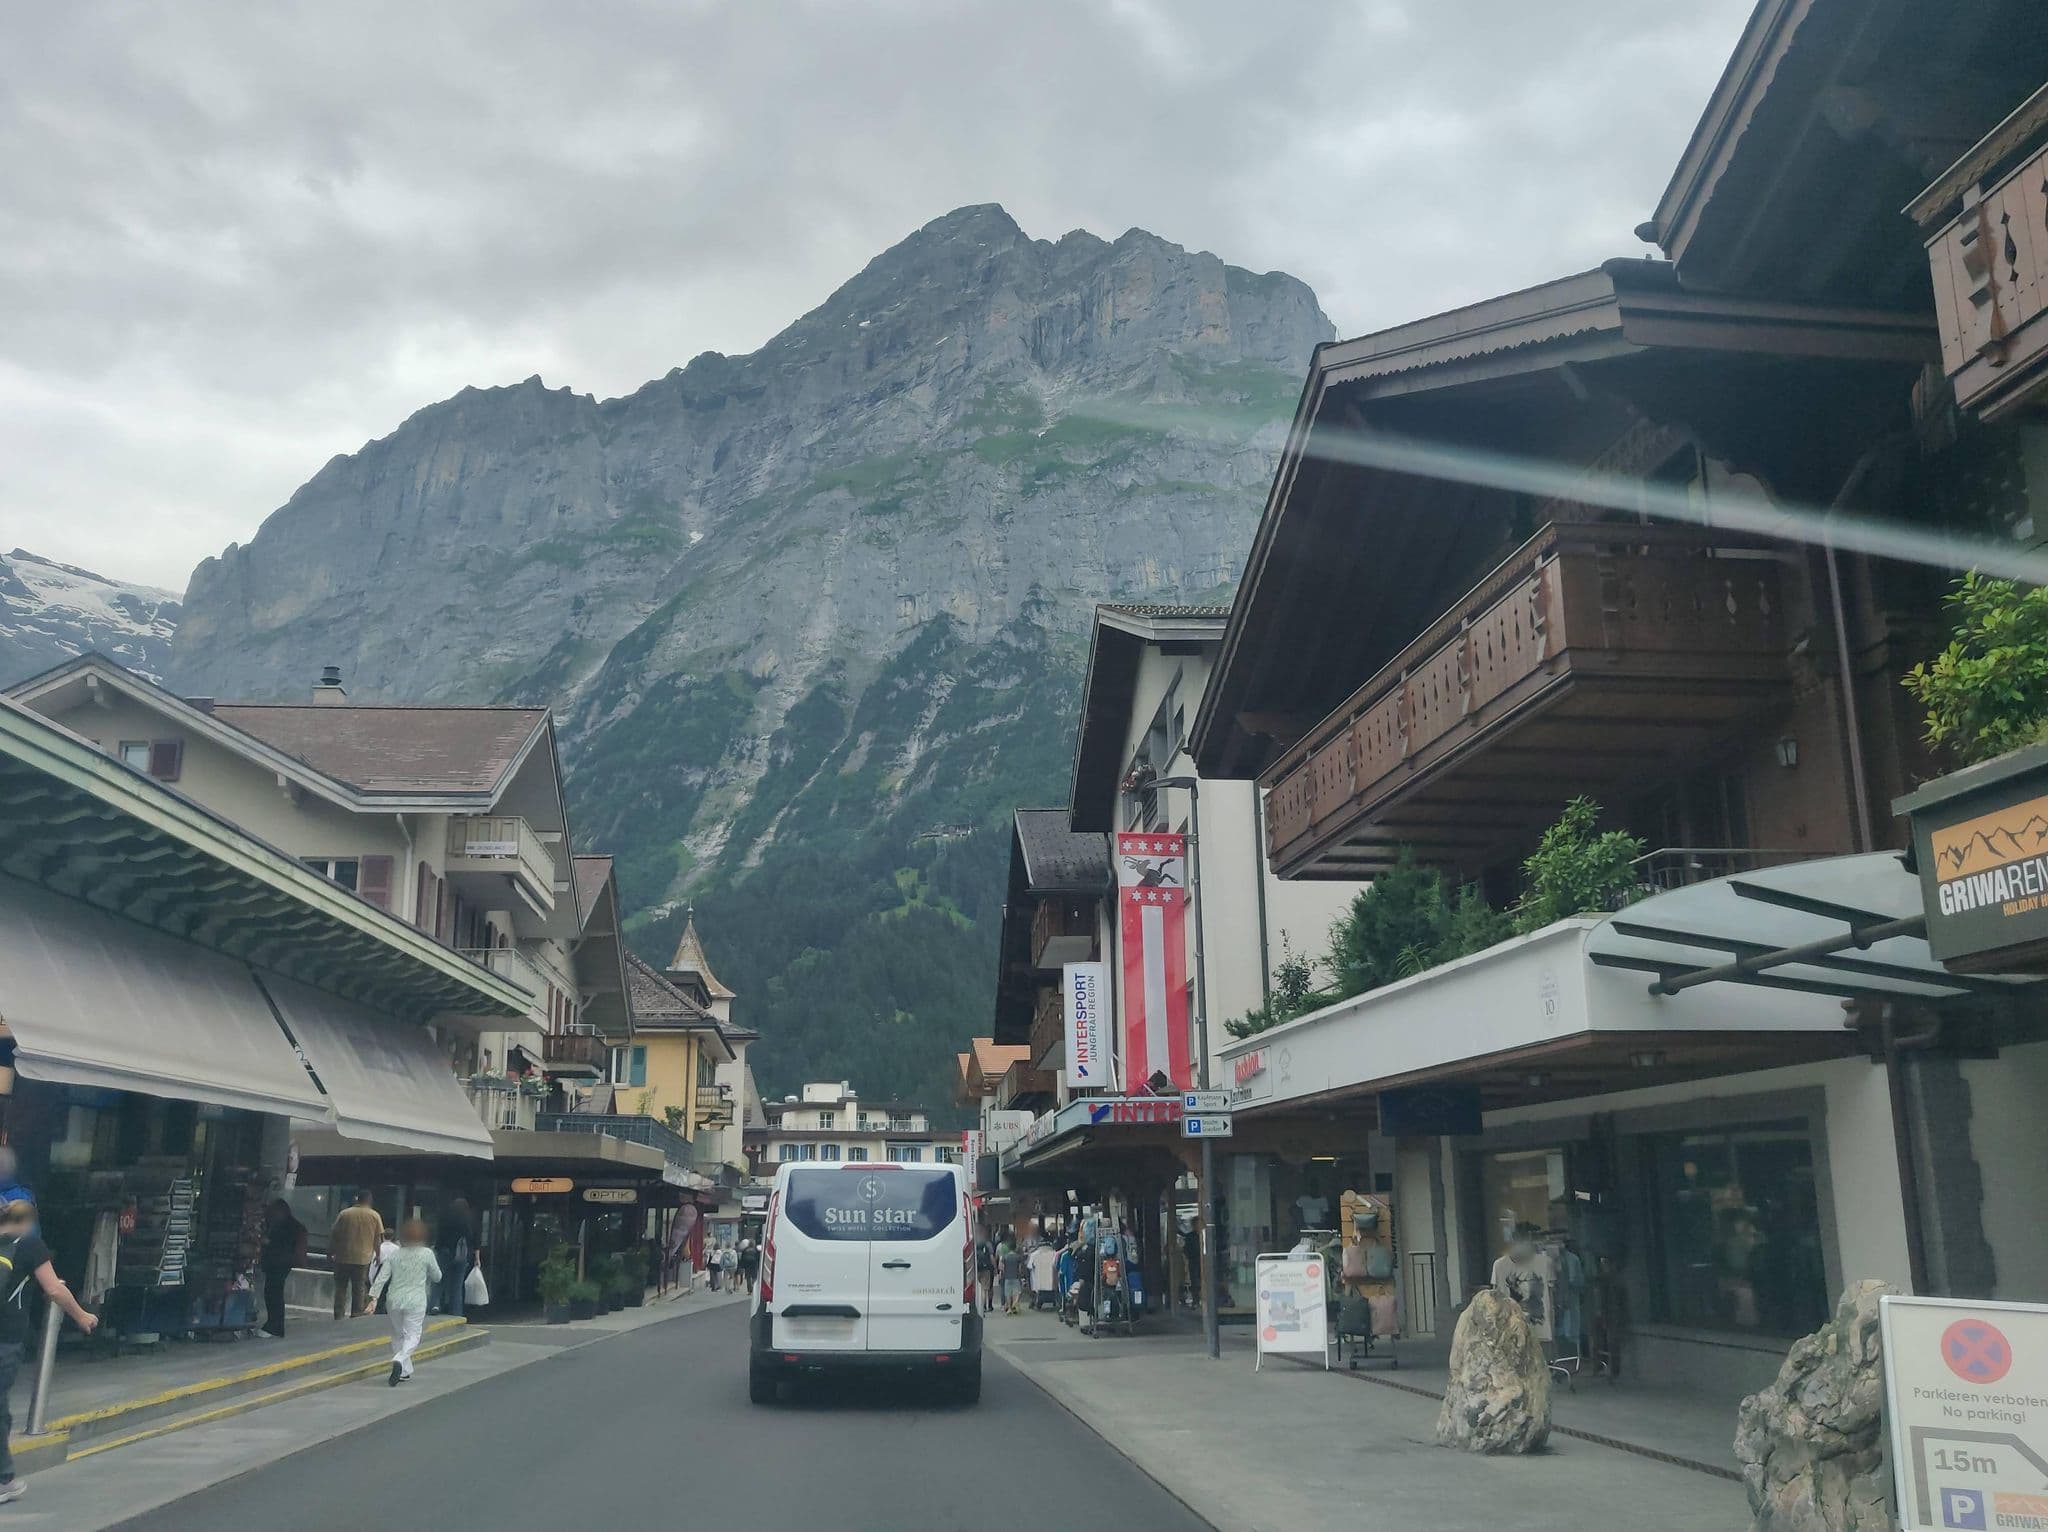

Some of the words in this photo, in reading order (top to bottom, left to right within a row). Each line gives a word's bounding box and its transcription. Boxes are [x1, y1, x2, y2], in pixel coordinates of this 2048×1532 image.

[2003, 895, 2039, 916] HOLIDAY
[1087, 975, 1096, 1010] REGION
[1075, 972, 1089, 1063] INTERSPORT
[1545, 999, 1555, 1016] 10
[1088, 1013, 1097, 1063] JUNGFRAU
[1003, 1121, 1019, 1131] UBS
[824, 1207, 867, 1224] Sun
[873, 1207, 917, 1224] star
[1914, 1387, 1979, 1403] Parkieren
[1943, 1405, 1963, 1417] No
[1968, 1408, 2026, 1424] parking!
[1934, 1448, 1998, 1474] 15m
[1950, 1494, 1976, 1524] P
